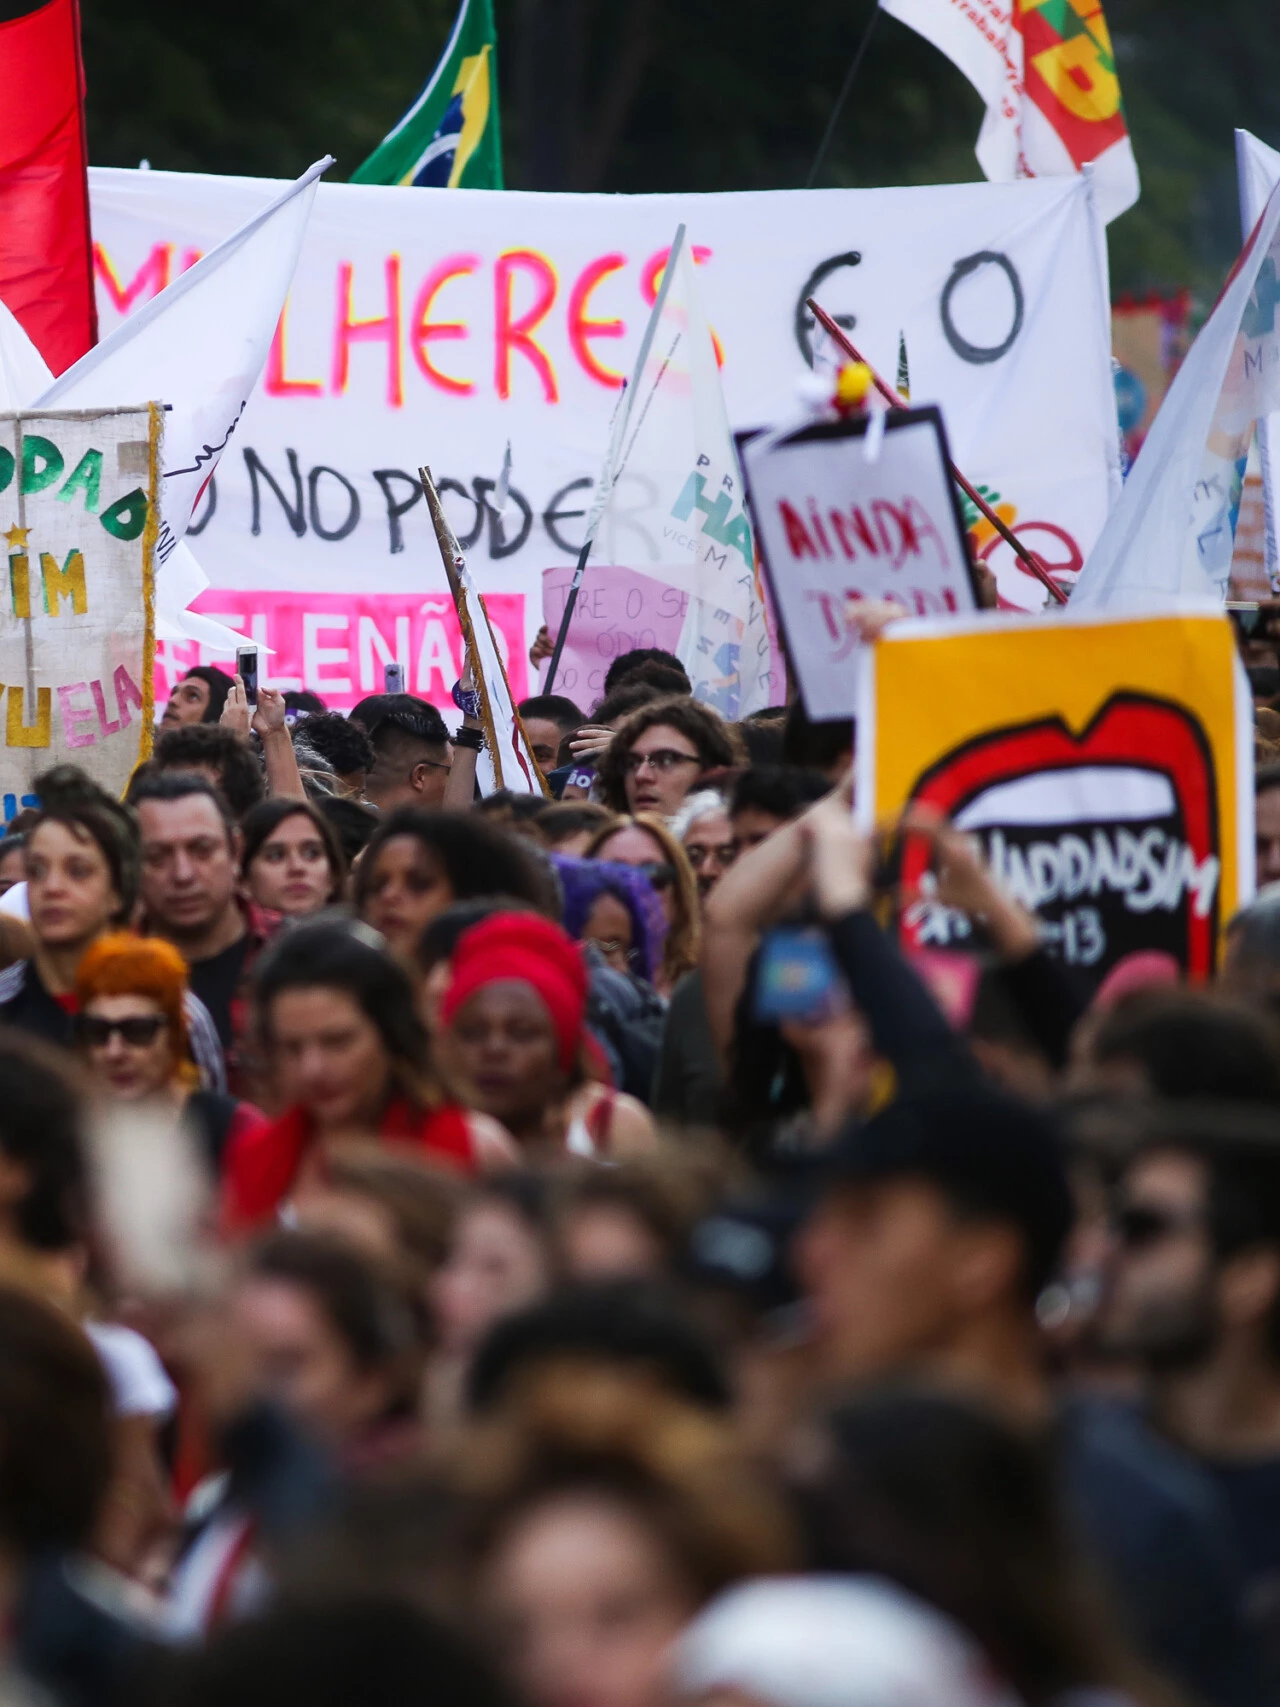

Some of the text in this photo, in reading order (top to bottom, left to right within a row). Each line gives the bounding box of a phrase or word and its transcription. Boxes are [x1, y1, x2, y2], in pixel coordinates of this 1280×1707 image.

[92, 243, 725, 408] MLHERES
[939, 250, 1024, 366] O
[242, 447, 361, 542] NO
